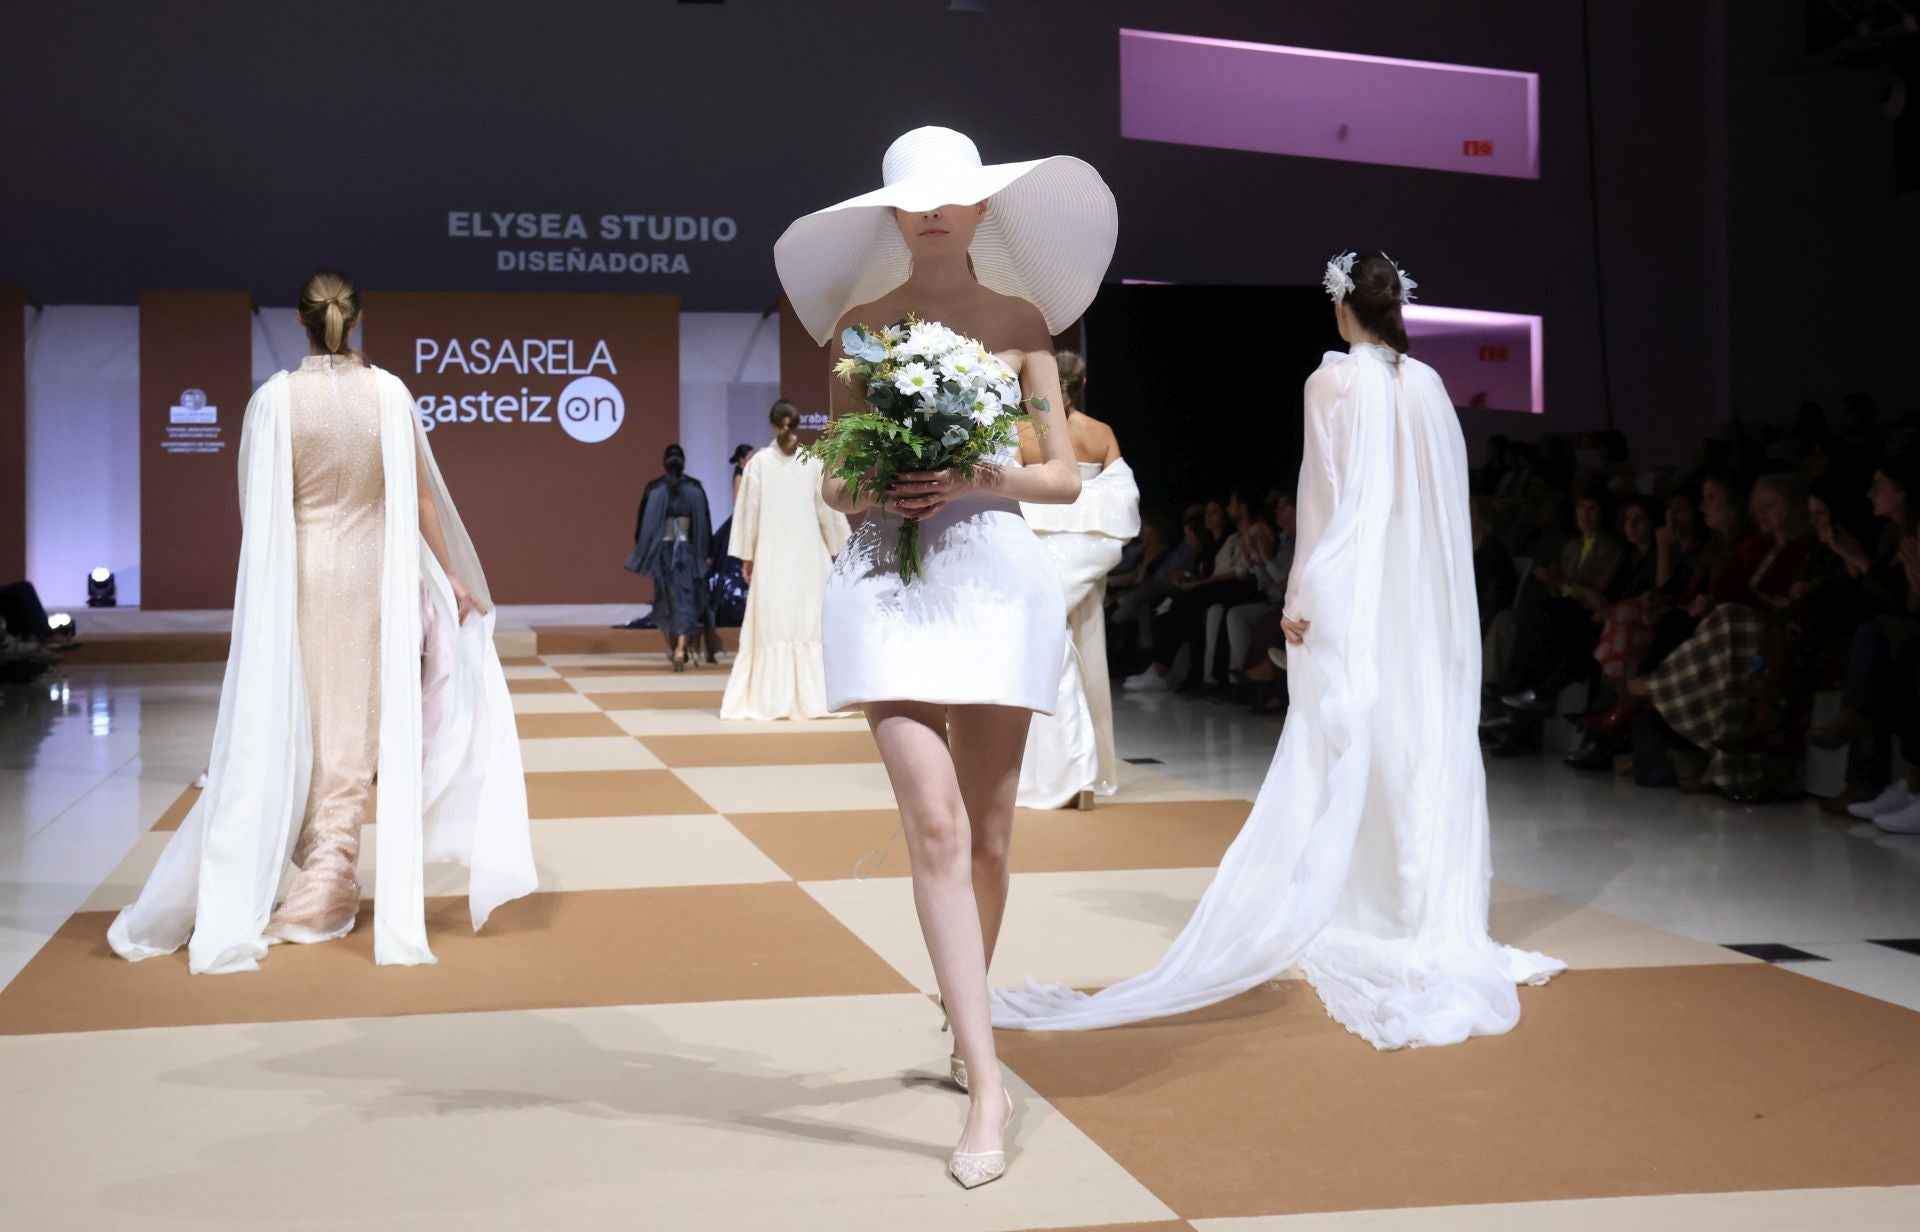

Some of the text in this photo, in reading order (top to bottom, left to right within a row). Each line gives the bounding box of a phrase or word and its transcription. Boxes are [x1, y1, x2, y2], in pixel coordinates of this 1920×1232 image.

[448, 211, 738, 242] ELYSEA STUDIO
[496, 248, 691, 274] DISEÑADORA
[415, 338, 618, 375] PASARELA
[416, 387, 552, 432] gasteiz
